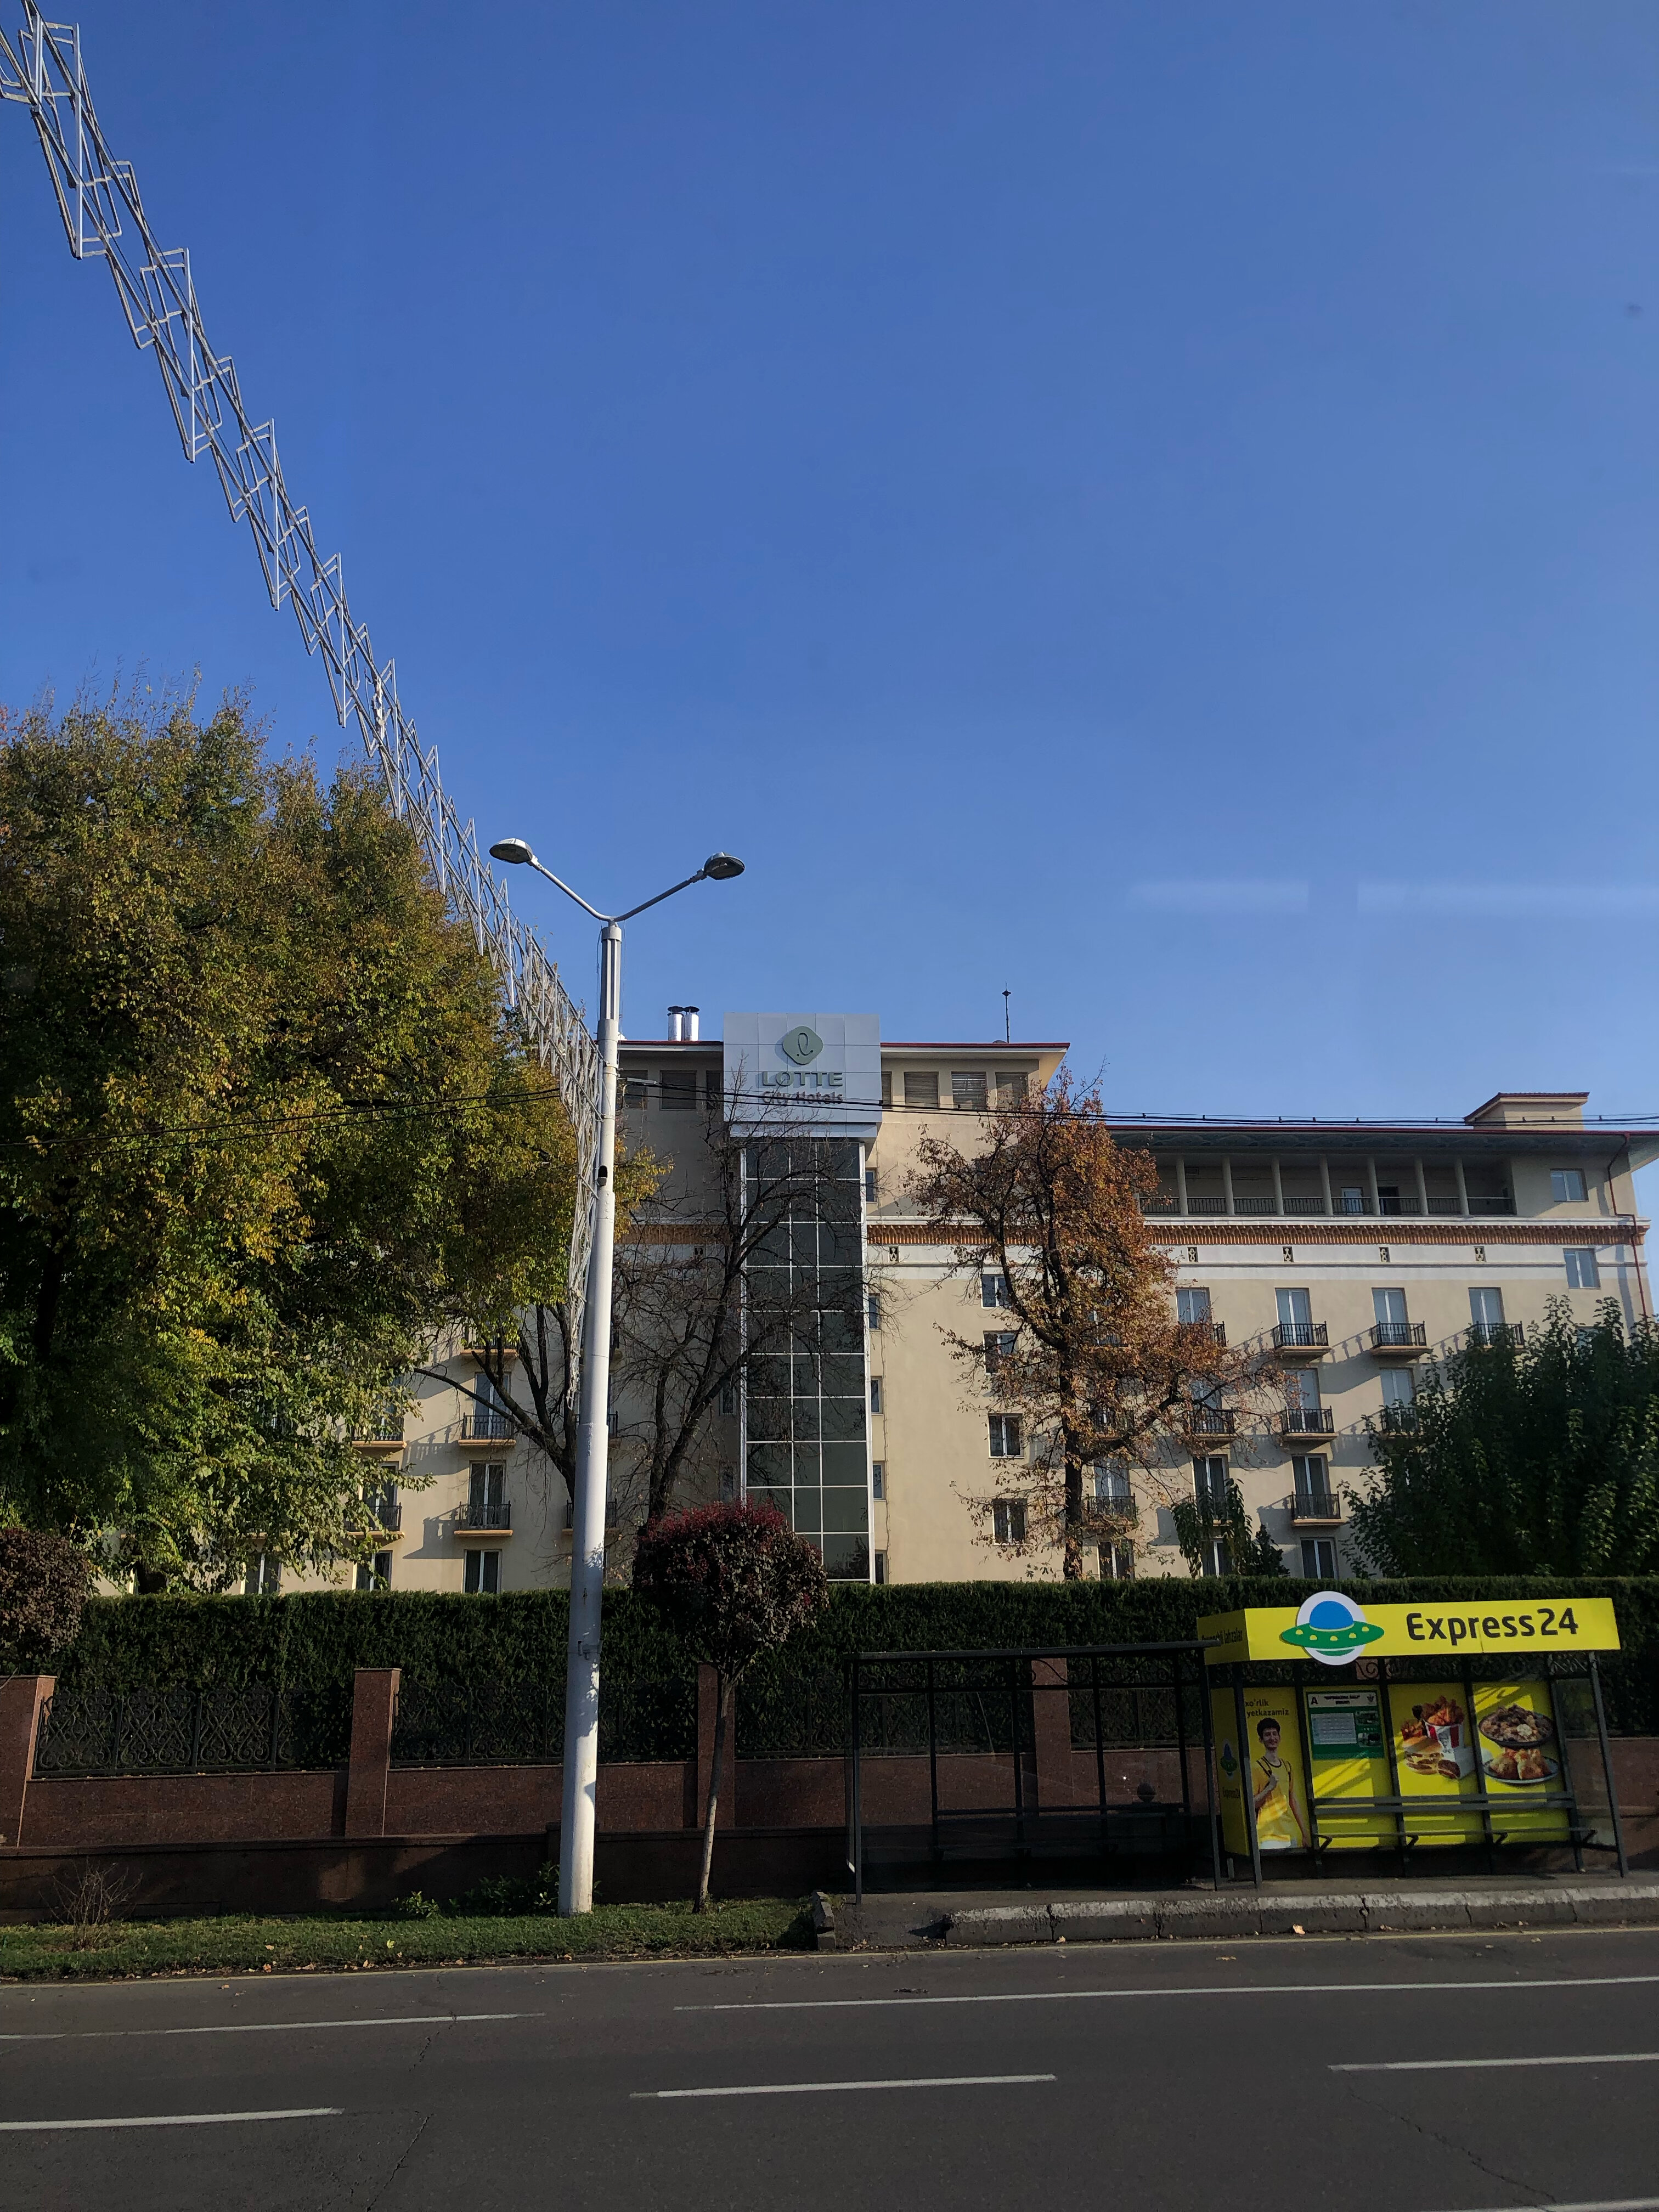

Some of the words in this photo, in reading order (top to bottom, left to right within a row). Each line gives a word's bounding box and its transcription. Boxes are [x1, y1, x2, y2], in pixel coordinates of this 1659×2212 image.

[762, 1071, 843, 1087] LOTTE
[763, 1091, 790, 1105] City
[796, 1091, 843, 1104] Hotels
[1406, 1607, 1578, 1646] Express24
[1311, 1696, 1319, 1705] A
[1246, 1707, 1289, 1718] yetkazamiz
